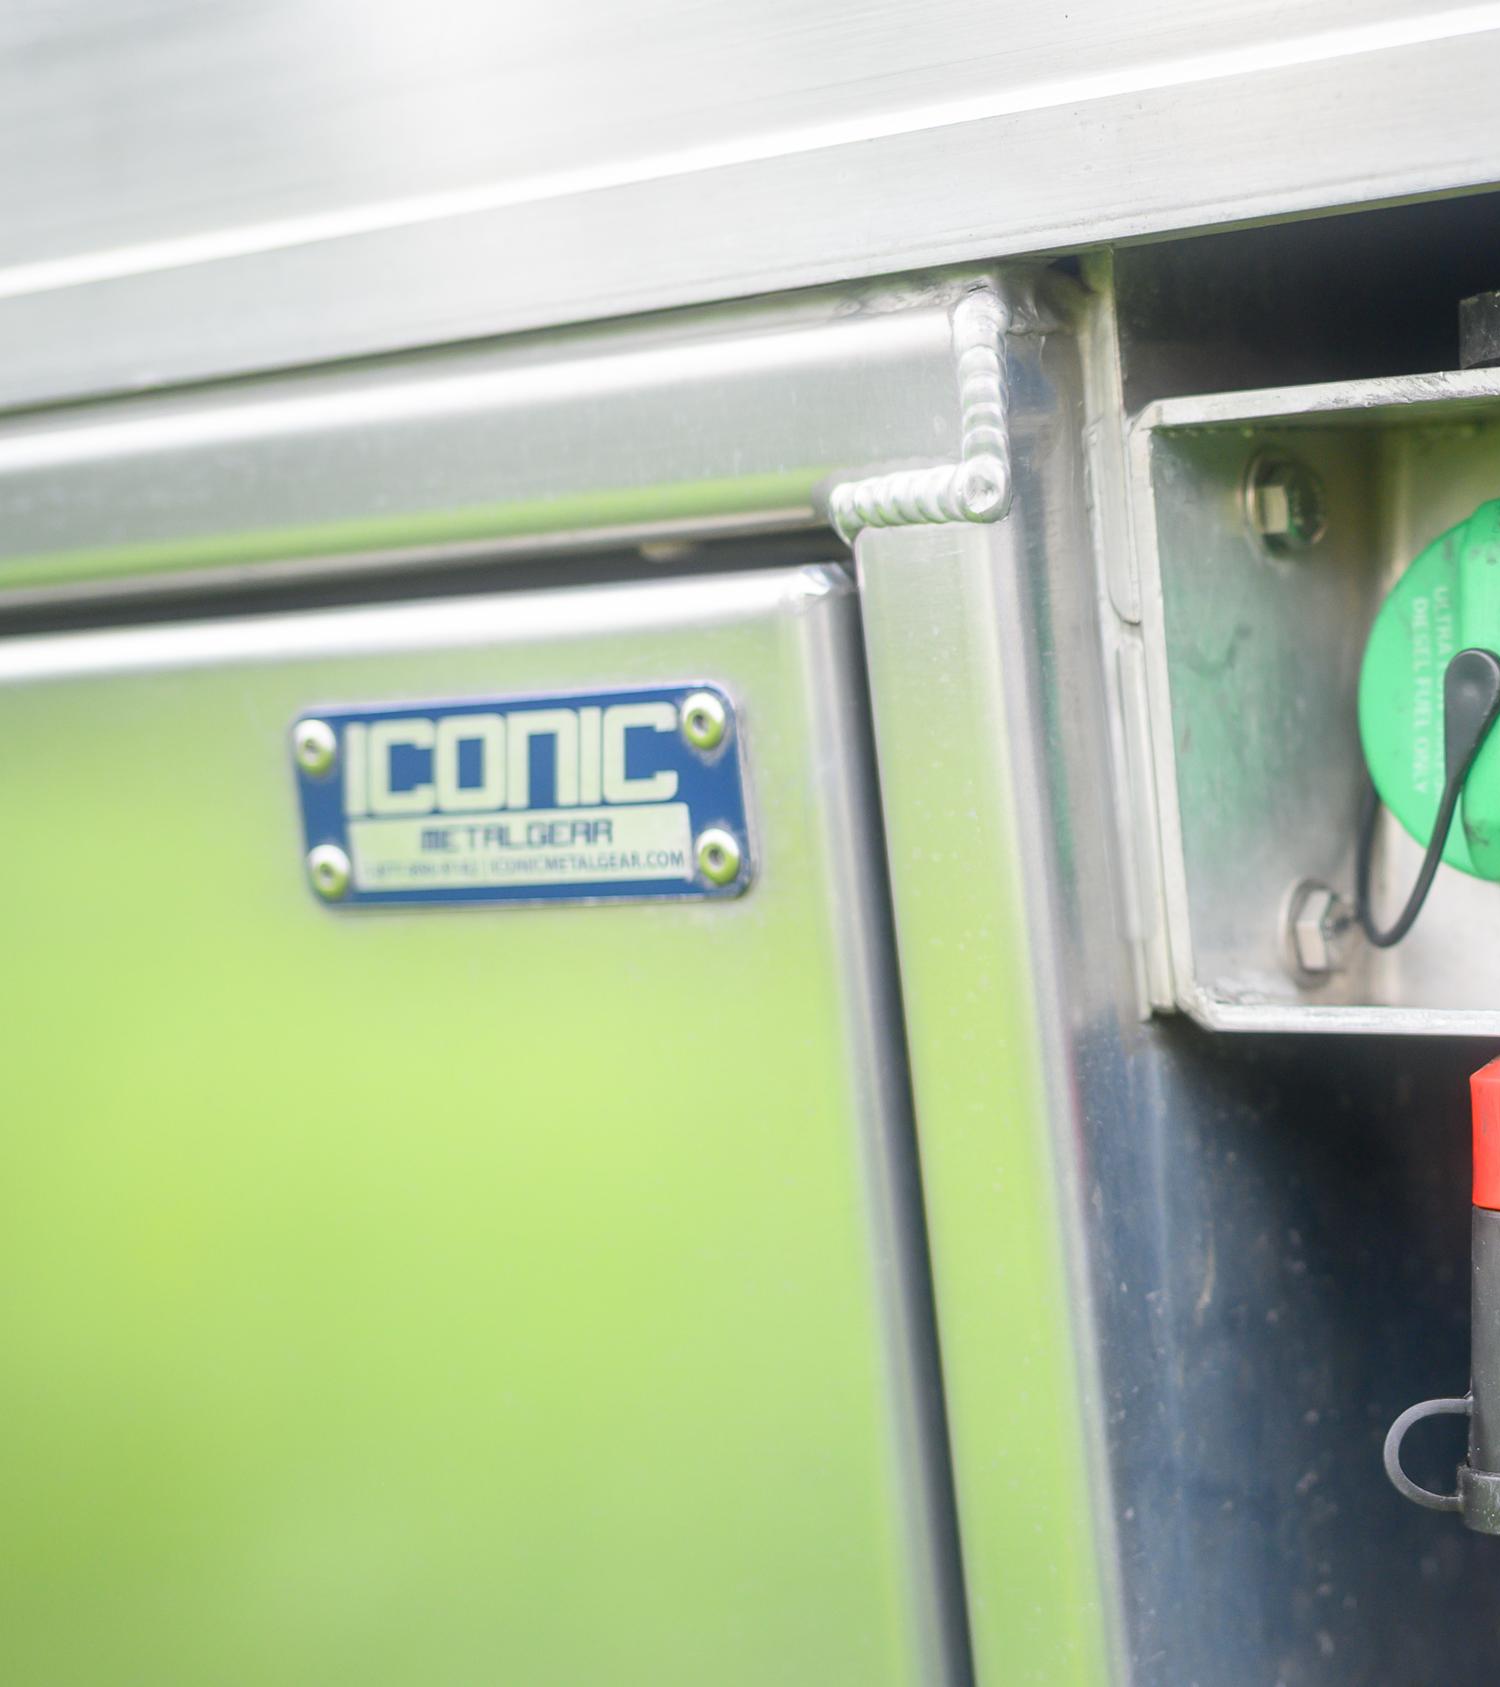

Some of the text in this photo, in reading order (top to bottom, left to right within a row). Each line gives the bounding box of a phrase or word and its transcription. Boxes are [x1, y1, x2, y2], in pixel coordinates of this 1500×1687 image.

[1435, 587, 1452, 655] ULTRA
[1413, 597, 1431, 793] DIESEL FUEL ONLY
[344, 701, 679, 816] ICONIC
[421, 819, 612, 852] METALGEAR
